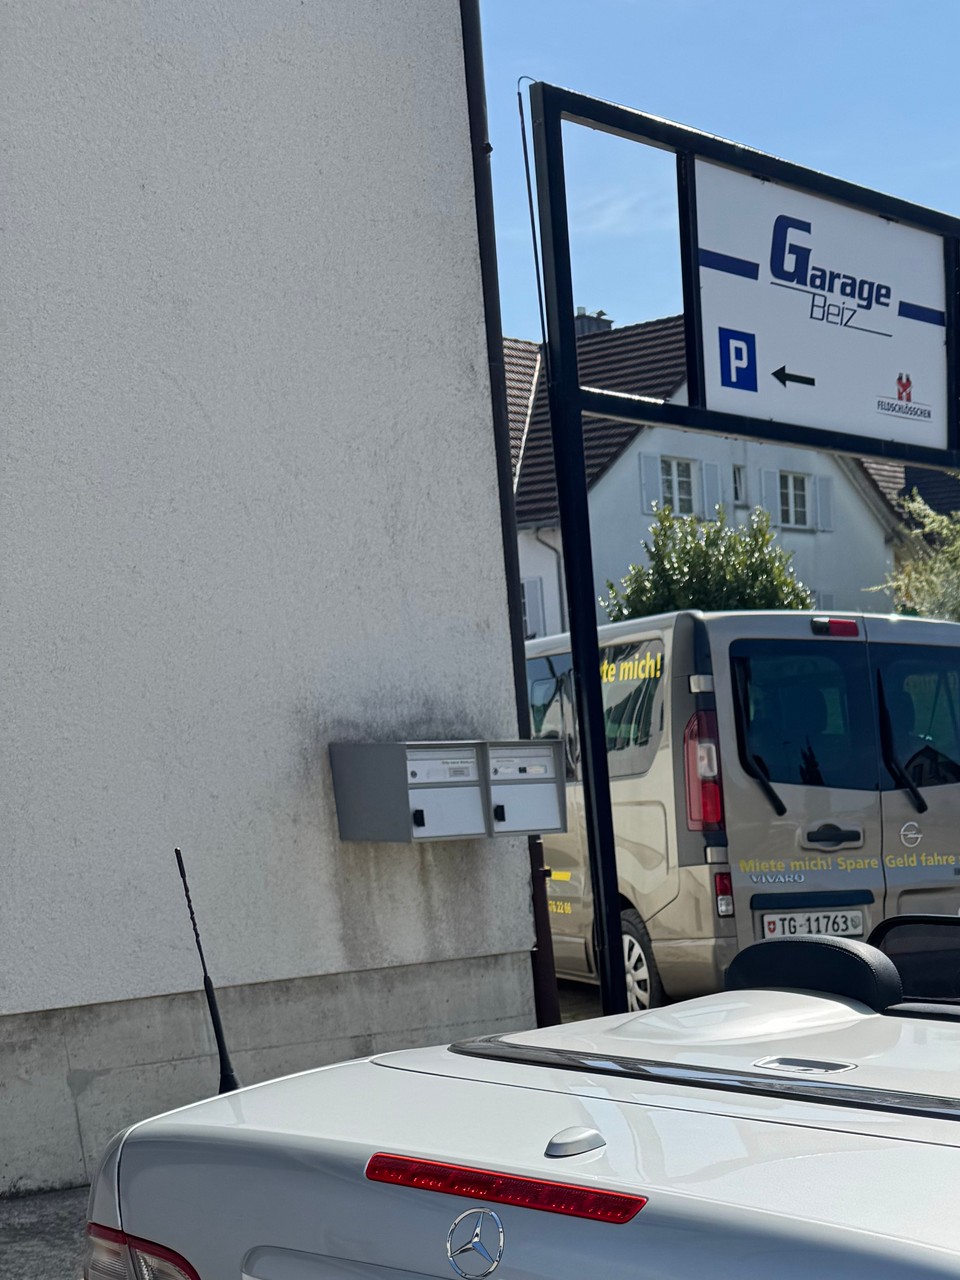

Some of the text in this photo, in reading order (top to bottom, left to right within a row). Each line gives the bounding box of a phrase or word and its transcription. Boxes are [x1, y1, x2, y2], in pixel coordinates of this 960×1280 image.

[770, 214, 892, 310] Garage
[809, 293, 858, 328] Beiz
[729, 338, 749, 383] P
[877, 399, 932, 419] FELDSCHLÖSSCHEN
[619, 651, 661, 682] mich!
[738, 859, 786, 873] Miete
[790, 857, 833, 871] mich!
[836, 856, 879, 873] Spare
[885, 853, 918, 868] Geld
[920, 851, 956, 866] fahre
[750, 873, 806, 884] VIVARO
